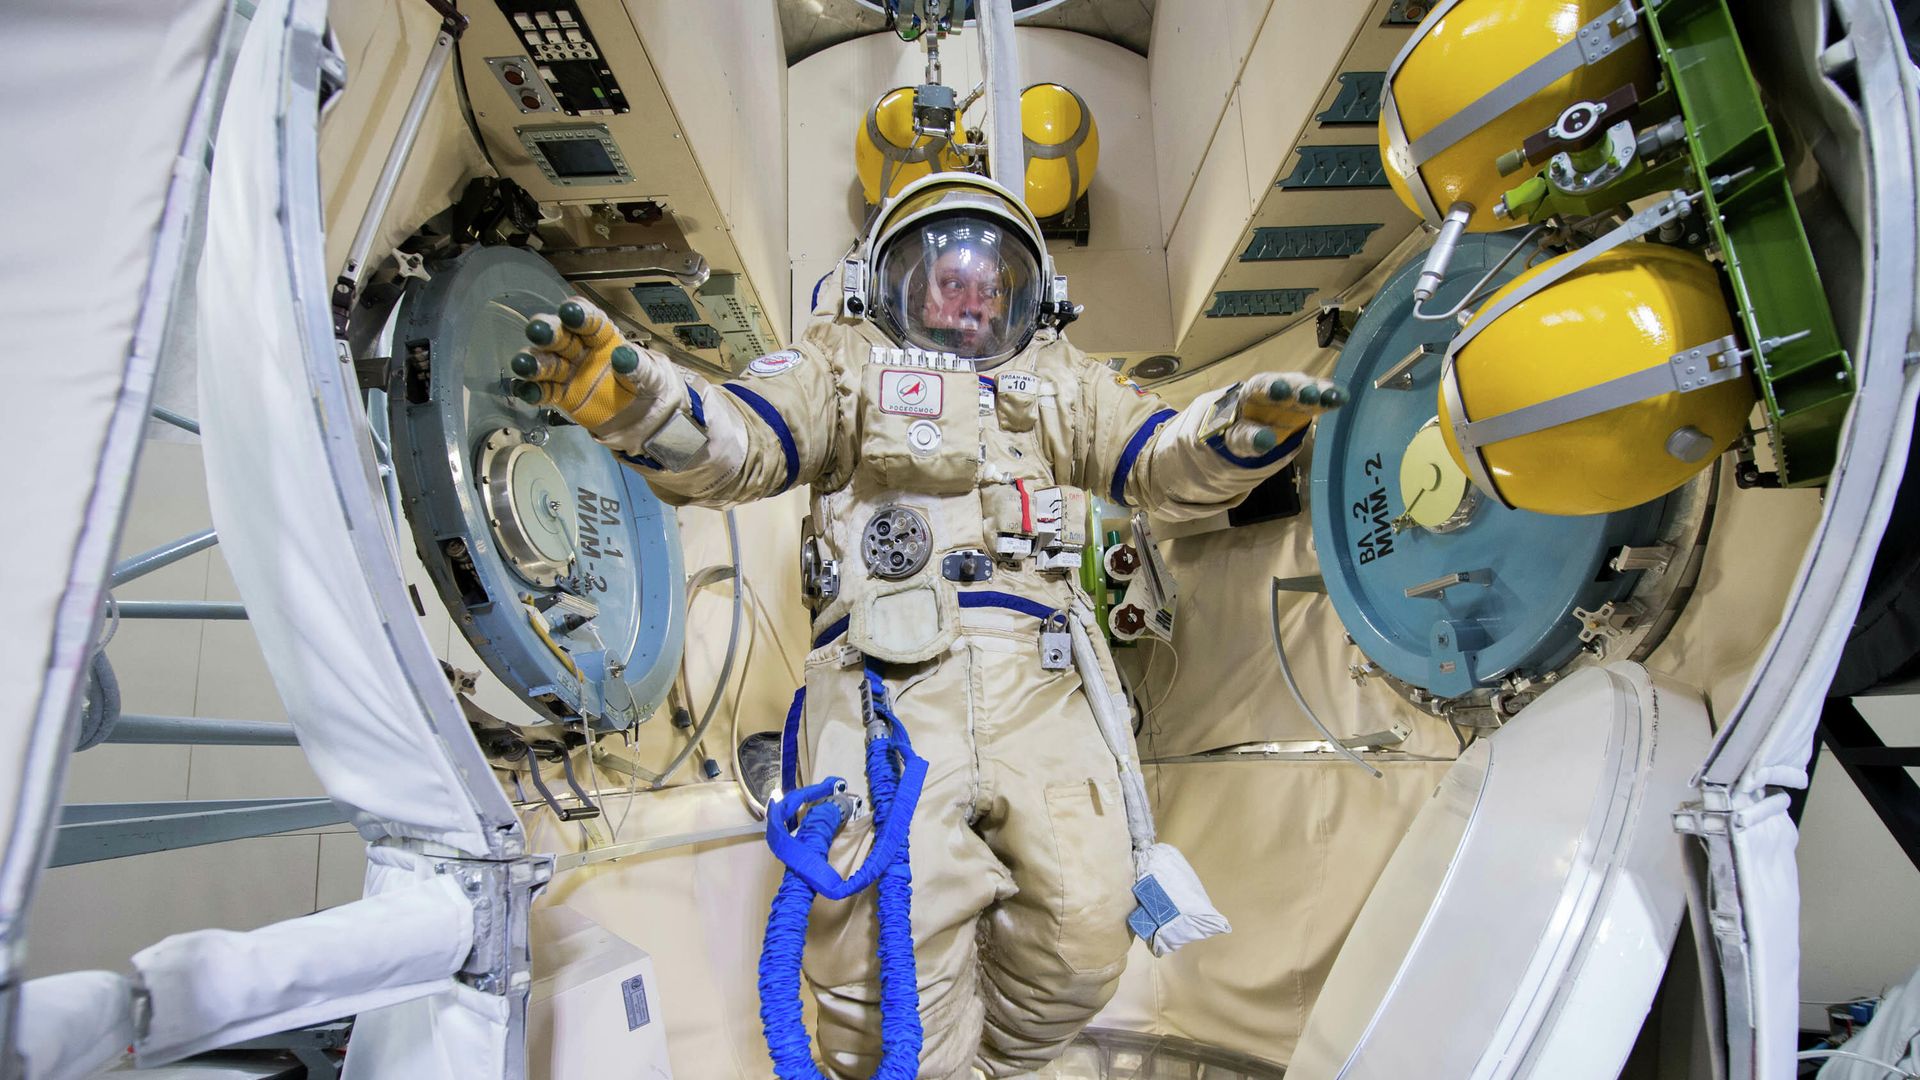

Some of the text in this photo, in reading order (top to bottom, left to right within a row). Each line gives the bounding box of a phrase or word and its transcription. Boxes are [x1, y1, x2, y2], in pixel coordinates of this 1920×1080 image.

[889, 405, 934, 414] РОСКОСМОС
[577, 487, 608, 593] МИМ-2
[1365, 452, 1394, 558] МИМ-2
